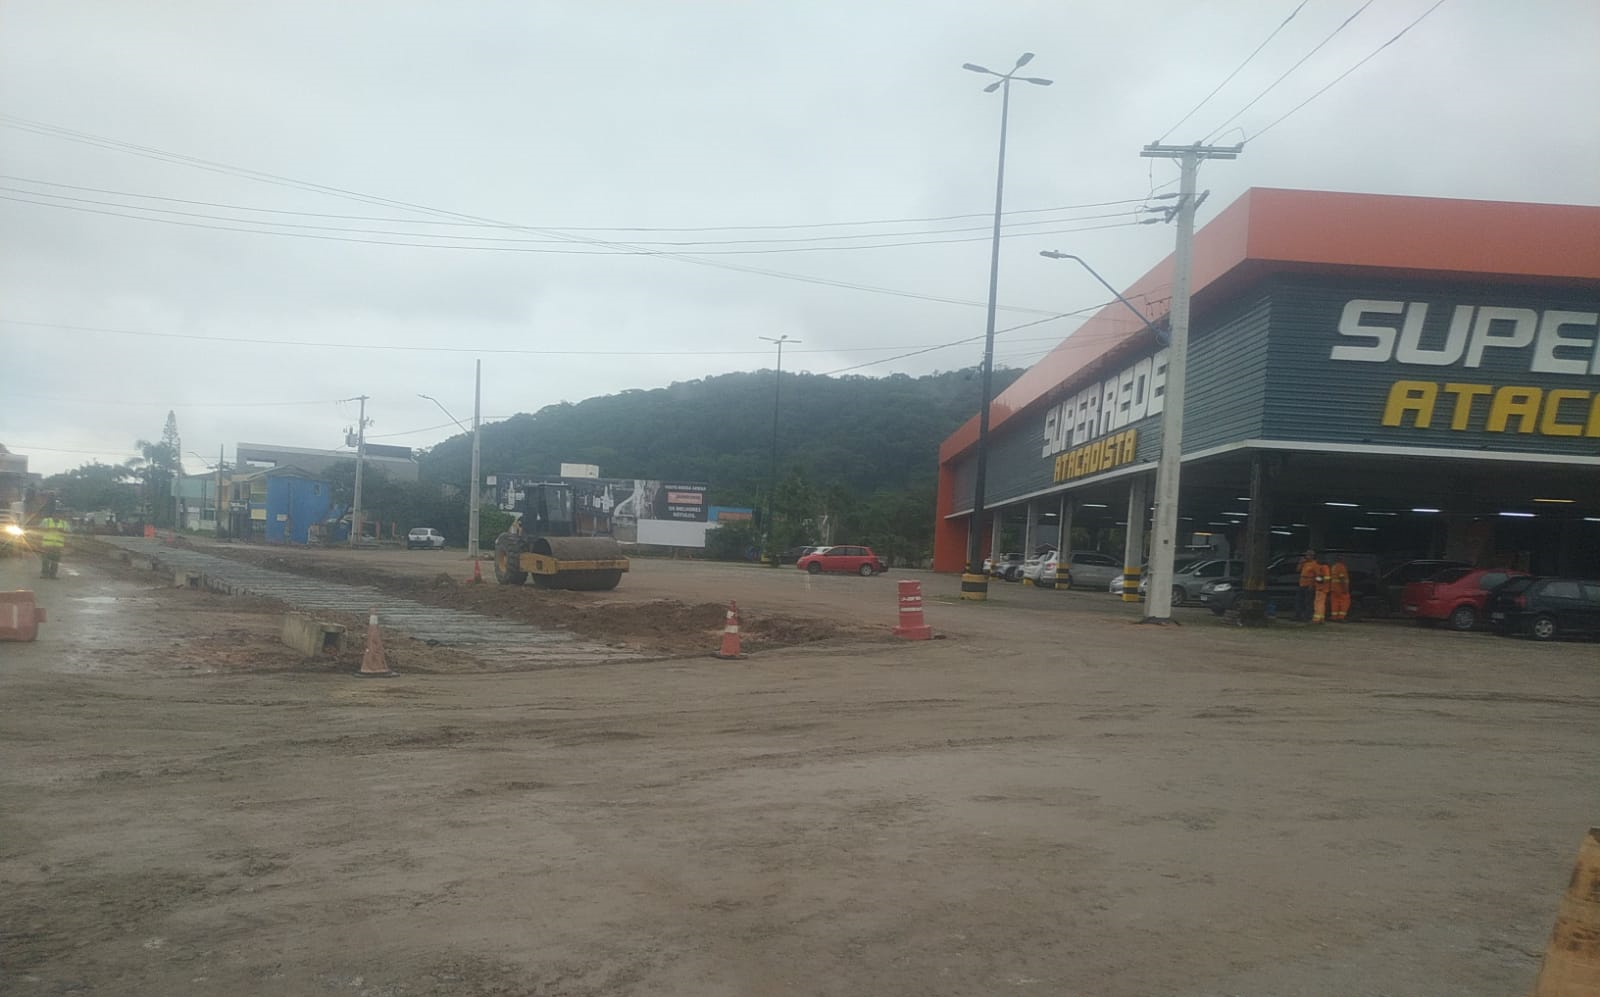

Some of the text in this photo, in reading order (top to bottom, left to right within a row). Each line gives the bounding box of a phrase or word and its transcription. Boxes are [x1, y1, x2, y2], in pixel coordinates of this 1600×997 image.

[1330, 299, 1600, 375] SUPE
[1042, 347, 1169, 458] SUPER REDE
[1054, 429, 1137, 481] ATACADISTA
